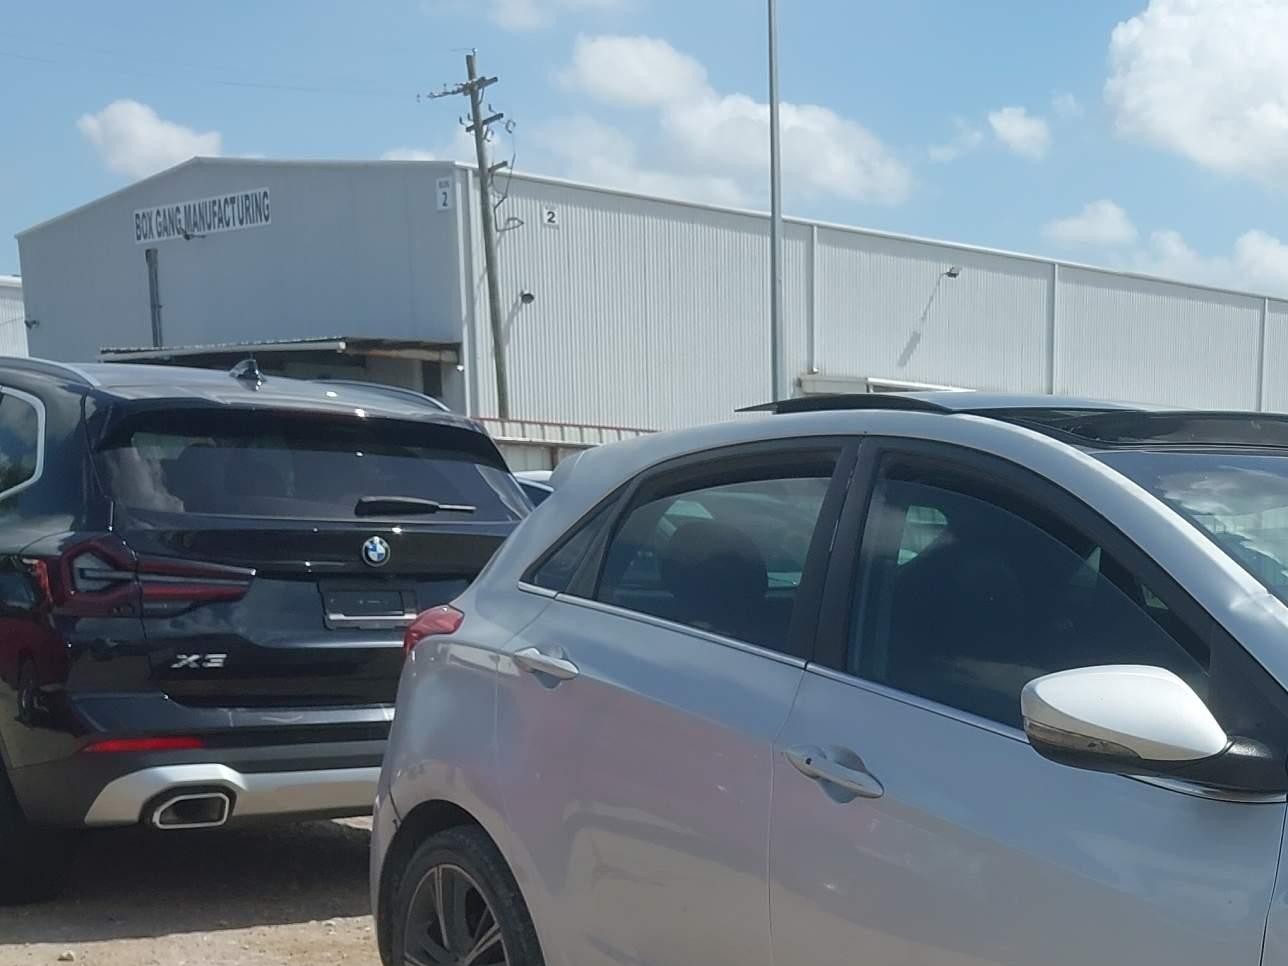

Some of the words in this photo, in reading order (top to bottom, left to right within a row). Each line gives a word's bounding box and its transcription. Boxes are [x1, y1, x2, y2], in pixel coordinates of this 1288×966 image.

[441, 191, 448, 207] 2
[135, 212, 154, 241] BOX
[156, 206, 181, 238] GANG
[184, 190, 270, 233] MANUFACTURING
[547, 211, 556, 224] 2
[171, 653, 228, 669] X3
